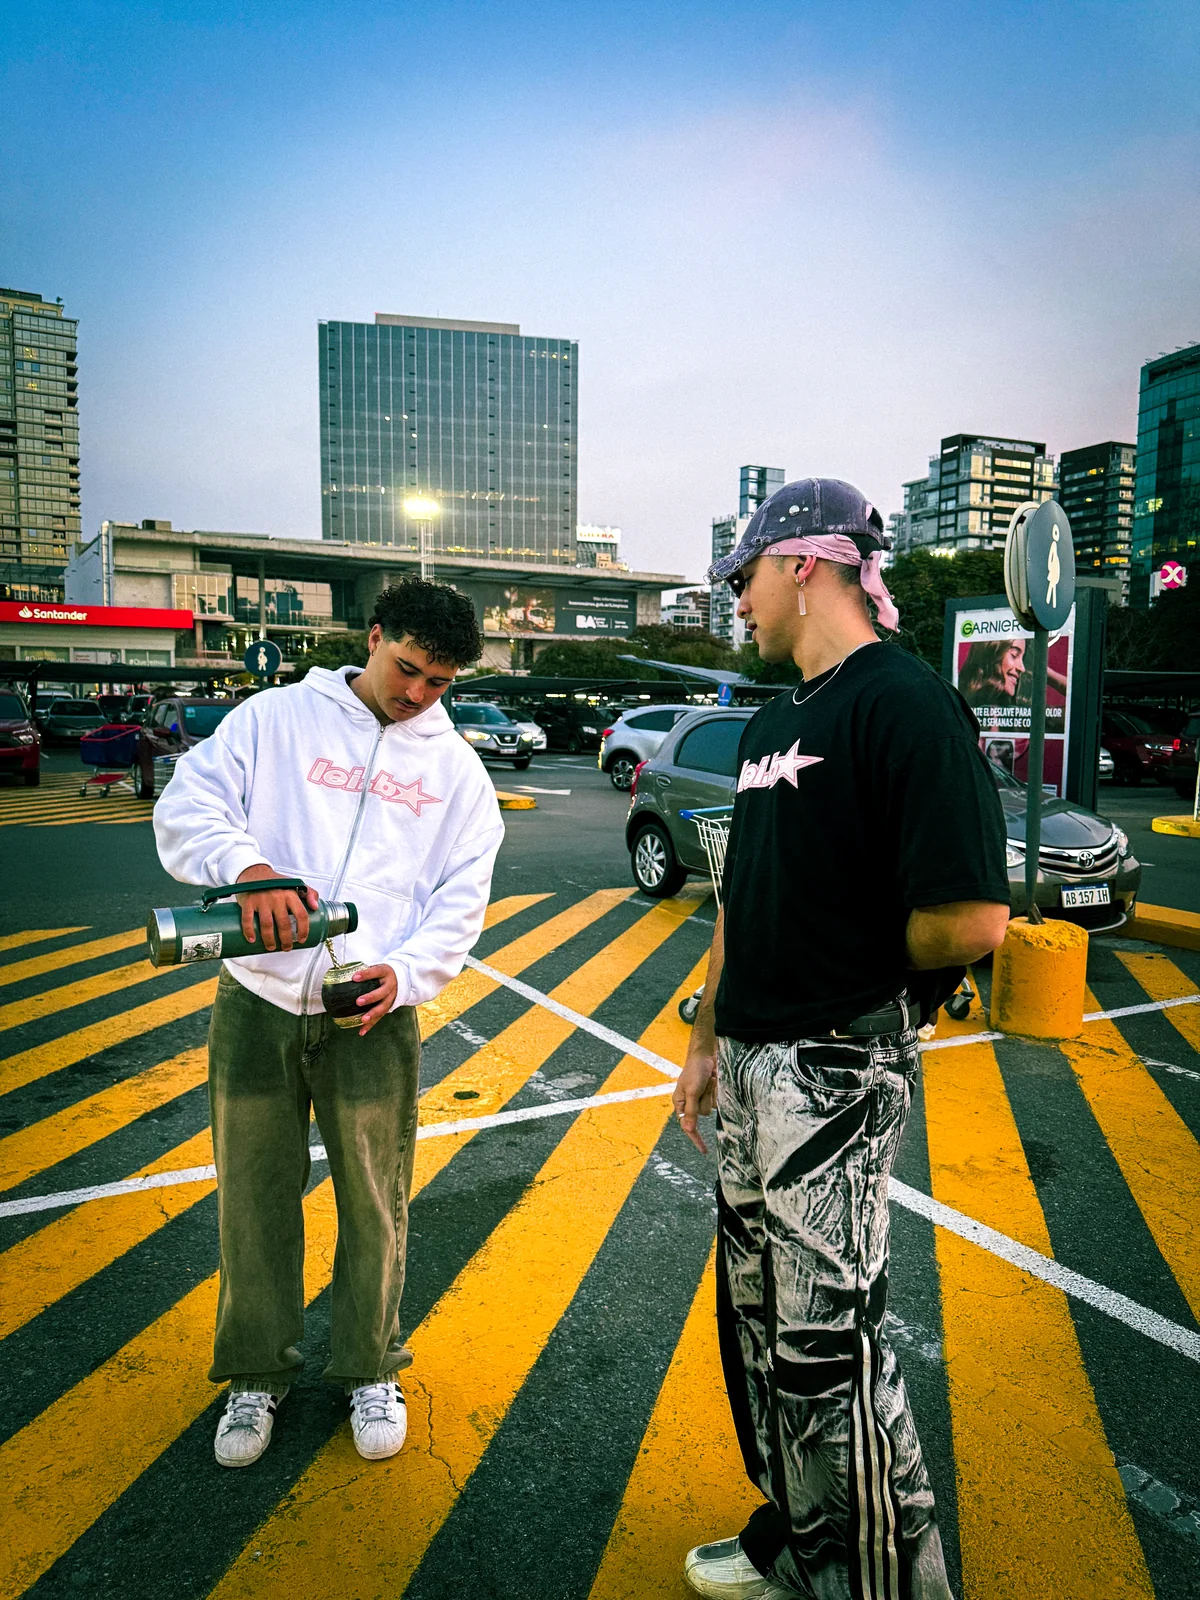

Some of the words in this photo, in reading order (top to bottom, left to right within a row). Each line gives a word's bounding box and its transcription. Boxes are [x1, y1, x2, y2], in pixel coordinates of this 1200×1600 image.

[33, 608, 87, 621] Santander
[961, 619, 1021, 636] GARNIER
[972, 707, 983, 717] ATE
[983, 707, 990, 717] EL
[990, 707, 1014, 717] DESLAVE
[1015, 707, 1031, 718] PARA
[1045, 708, 1062, 718] OLOR
[987, 718, 1013, 728] SEMANAS
[1014, 718, 1022, 728] DE
[1022, 718, 1031, 728] CO
[1065, 891, 1077, 906] AB
[1078, 890, 1094, 905] 157
